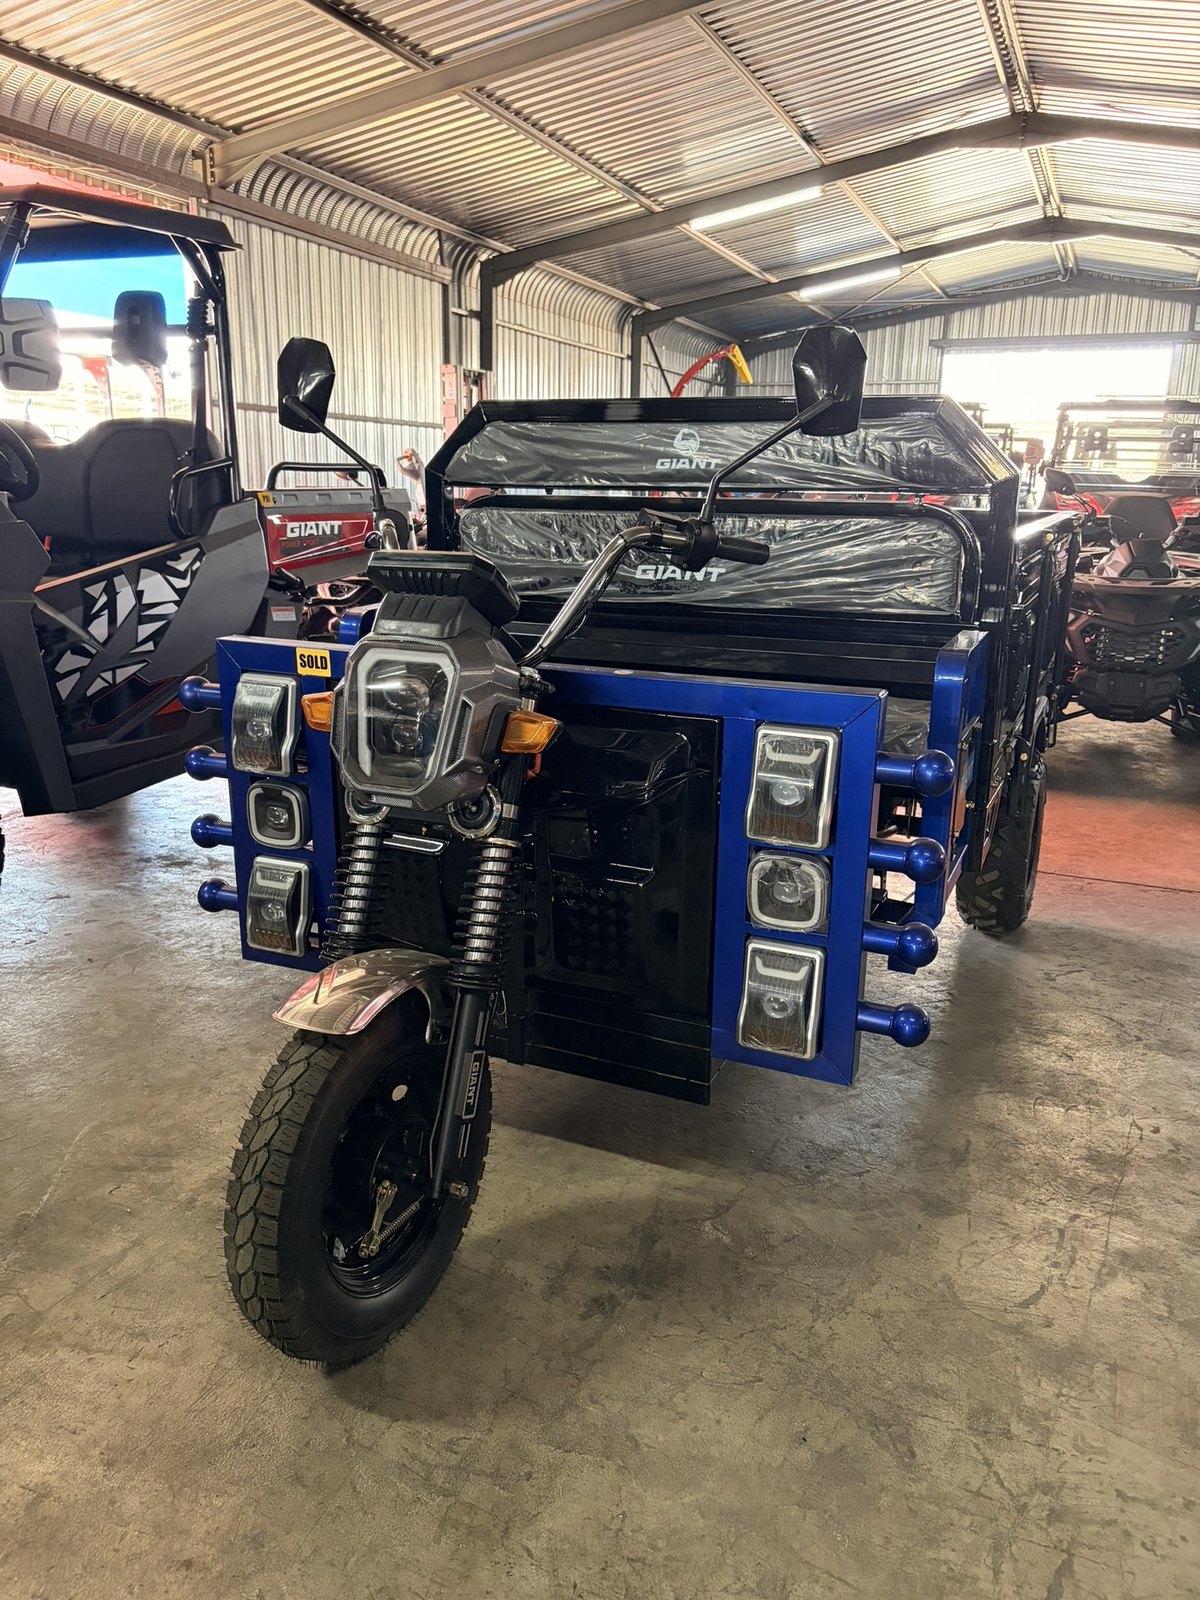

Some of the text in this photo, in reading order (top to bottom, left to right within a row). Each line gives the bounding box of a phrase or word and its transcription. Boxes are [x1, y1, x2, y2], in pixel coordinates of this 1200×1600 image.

[655, 458, 722, 470] GIANT
[286, 521, 343, 538] GIANT
[635, 564, 727, 582] GIANT
[299, 653, 328, 670] SOLD
[467, 1061, 480, 1106] GIANT
